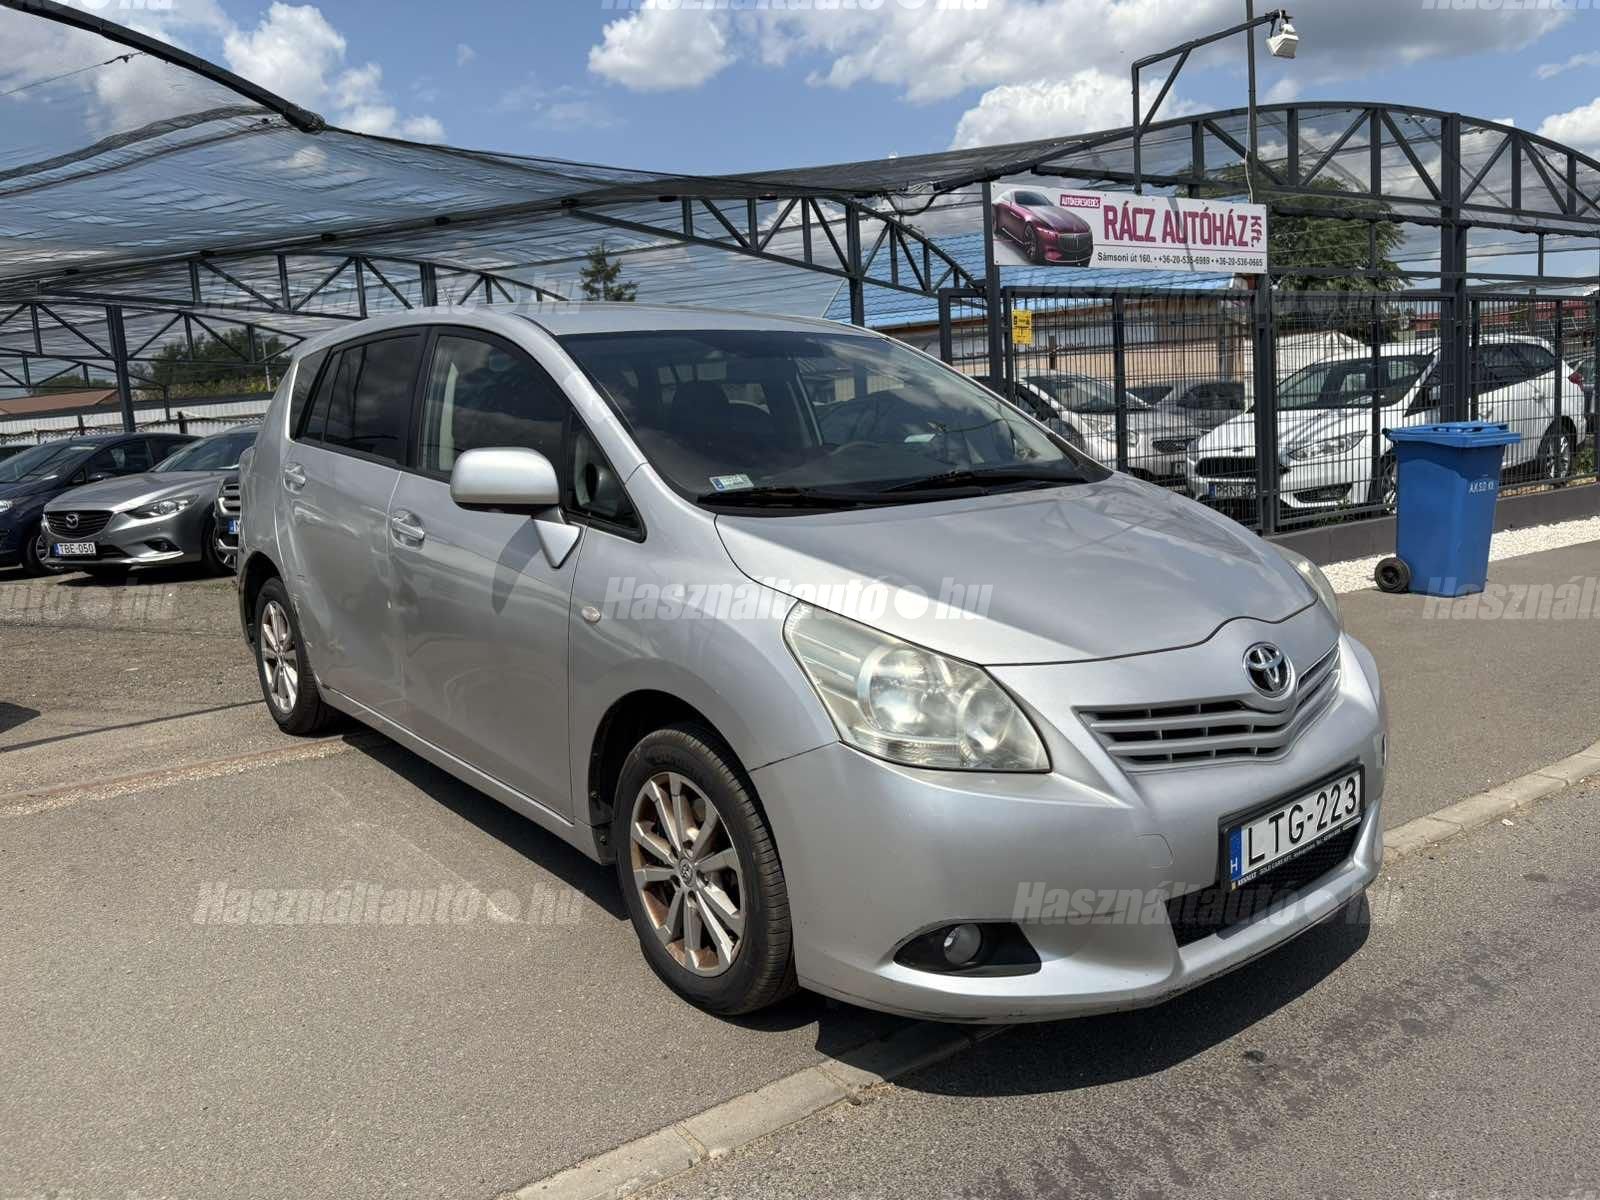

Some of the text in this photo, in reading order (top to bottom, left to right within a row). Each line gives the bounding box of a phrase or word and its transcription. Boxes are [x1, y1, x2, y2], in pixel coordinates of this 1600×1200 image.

[1103, 200, 1249, 247] RÁCZ AUTÓHÁZ
[1250, 216, 1263, 248] Kft.
[60, 543, 94, 554] TBE-050
[1248, 776, 1357, 866] LTG-223
